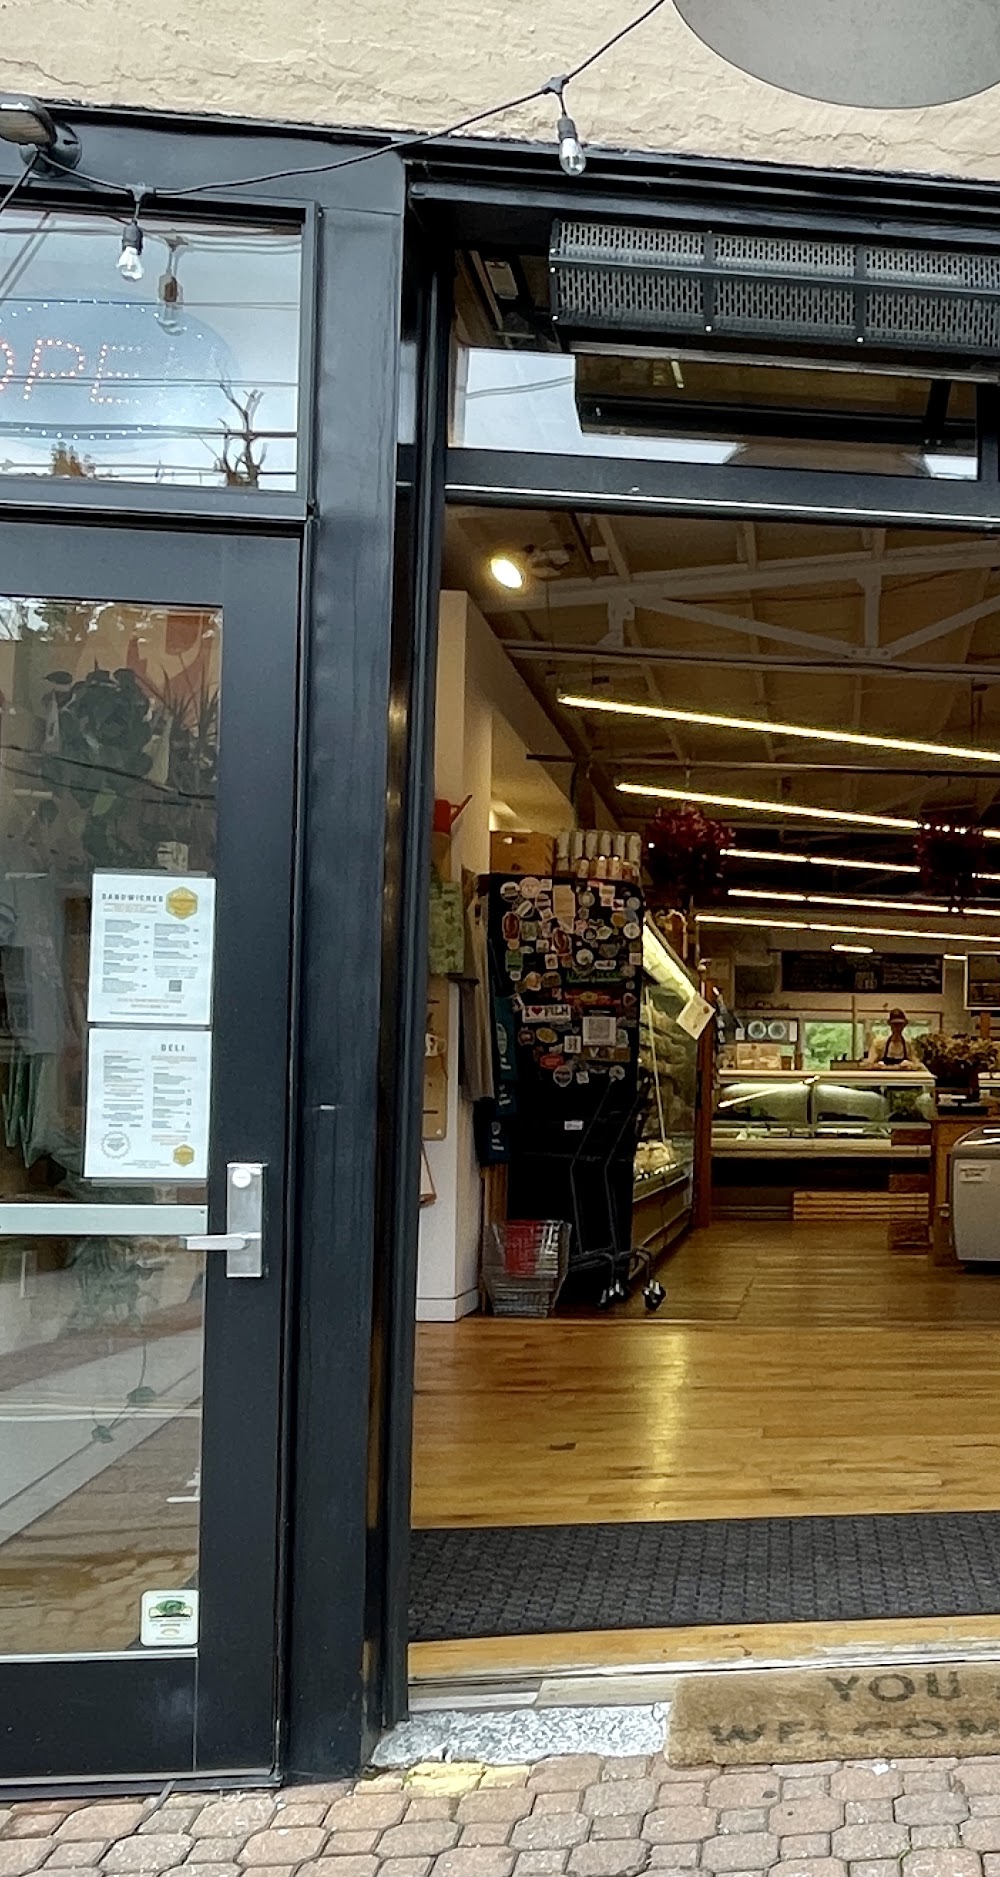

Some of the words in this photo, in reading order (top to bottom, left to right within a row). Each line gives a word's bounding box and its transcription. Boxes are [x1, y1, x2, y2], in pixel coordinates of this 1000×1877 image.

[0, 338, 217, 405] PE
[101, 892, 164, 903] SANDWICHES
[161, 1043, 185, 1052] DELI
[826, 1670, 965, 1702] YOU
